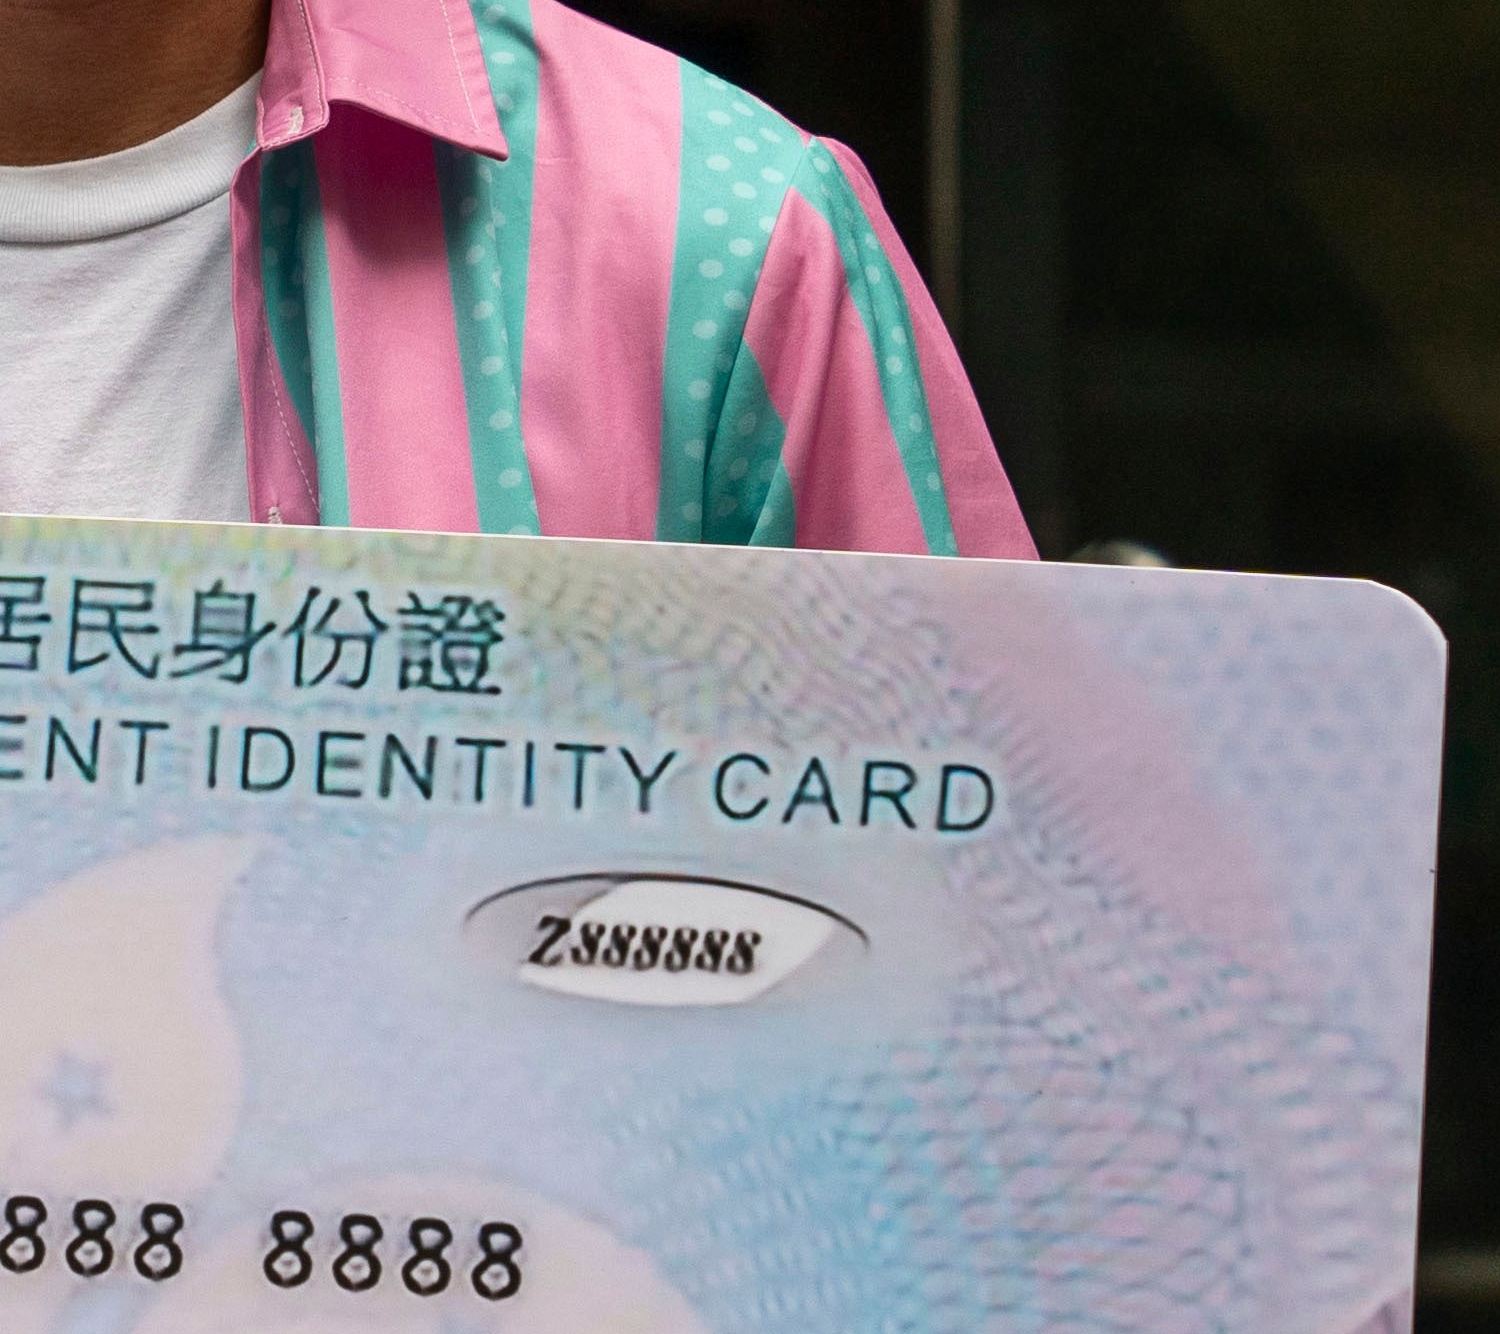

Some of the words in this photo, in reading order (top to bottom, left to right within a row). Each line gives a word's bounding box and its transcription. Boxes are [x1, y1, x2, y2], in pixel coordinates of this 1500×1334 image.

[205, 722, 678, 815] IDENTITY
[713, 753, 996, 834] CARD
[526, 914, 763, 975] Z888888
[262, 1208, 524, 1300] 8888
